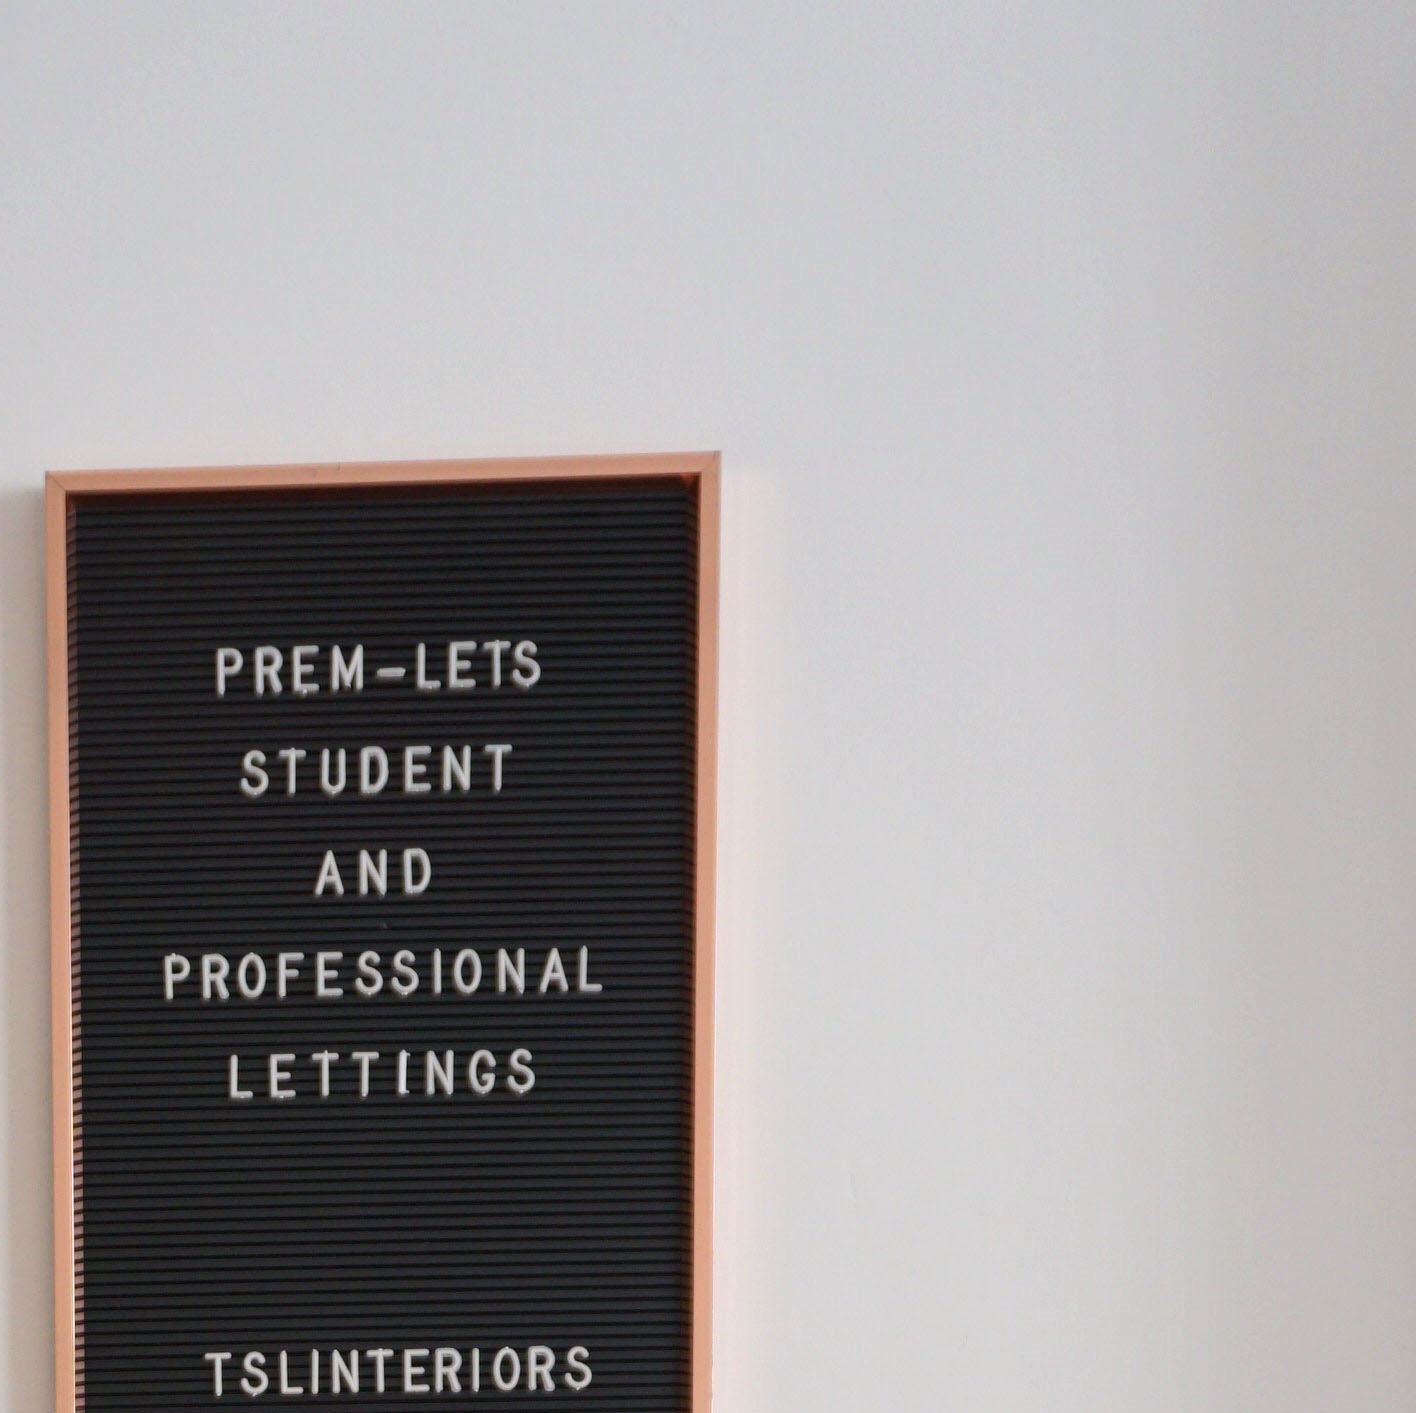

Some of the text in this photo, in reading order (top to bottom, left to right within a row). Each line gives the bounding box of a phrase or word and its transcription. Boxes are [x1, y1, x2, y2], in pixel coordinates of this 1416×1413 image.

[215, 639, 542, 697] PREM-LETS
[239, 743, 512, 797] STUDENT
[314, 846, 432, 896] AND
[163, 945, 603, 1000] PROFESSIONAL
[227, 1048, 536, 1100] LETTINGS
[204, 1346, 594, 1396] TSLINTERIORS
